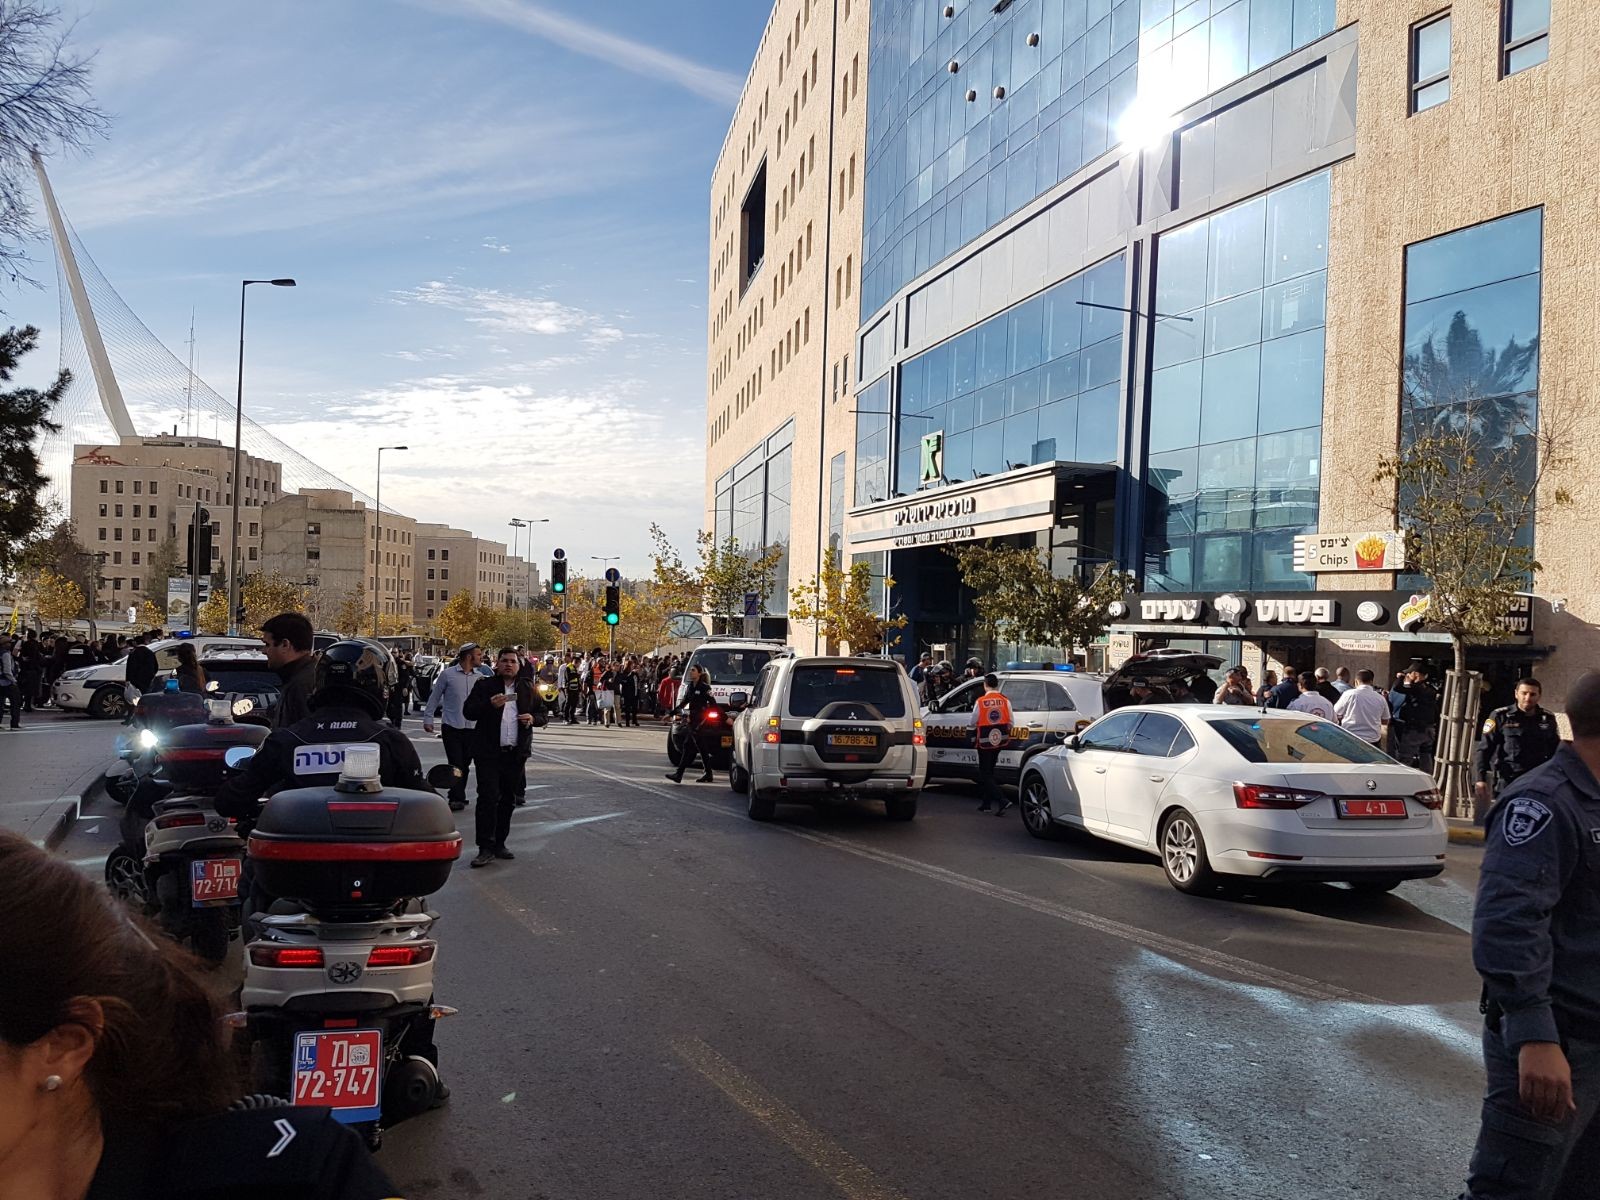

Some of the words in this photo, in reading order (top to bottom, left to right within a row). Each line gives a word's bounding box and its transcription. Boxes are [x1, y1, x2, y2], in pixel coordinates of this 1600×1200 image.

[894, 504, 933, 526] ירושלים
[934, 496, 975, 519] מרכזית
[1308, 544, 1317, 559] 5
[1320, 554, 1348, 567] Chips
[1140, 599, 1202, 621] טעים
[1255, 599, 1335, 623] פשוט
[329, 721, 358, 730] BLADE
[925, 725, 967, 738] POLICE
[295, 750, 345, 768] טרה
[301, 1046, 313, 1061] IL
